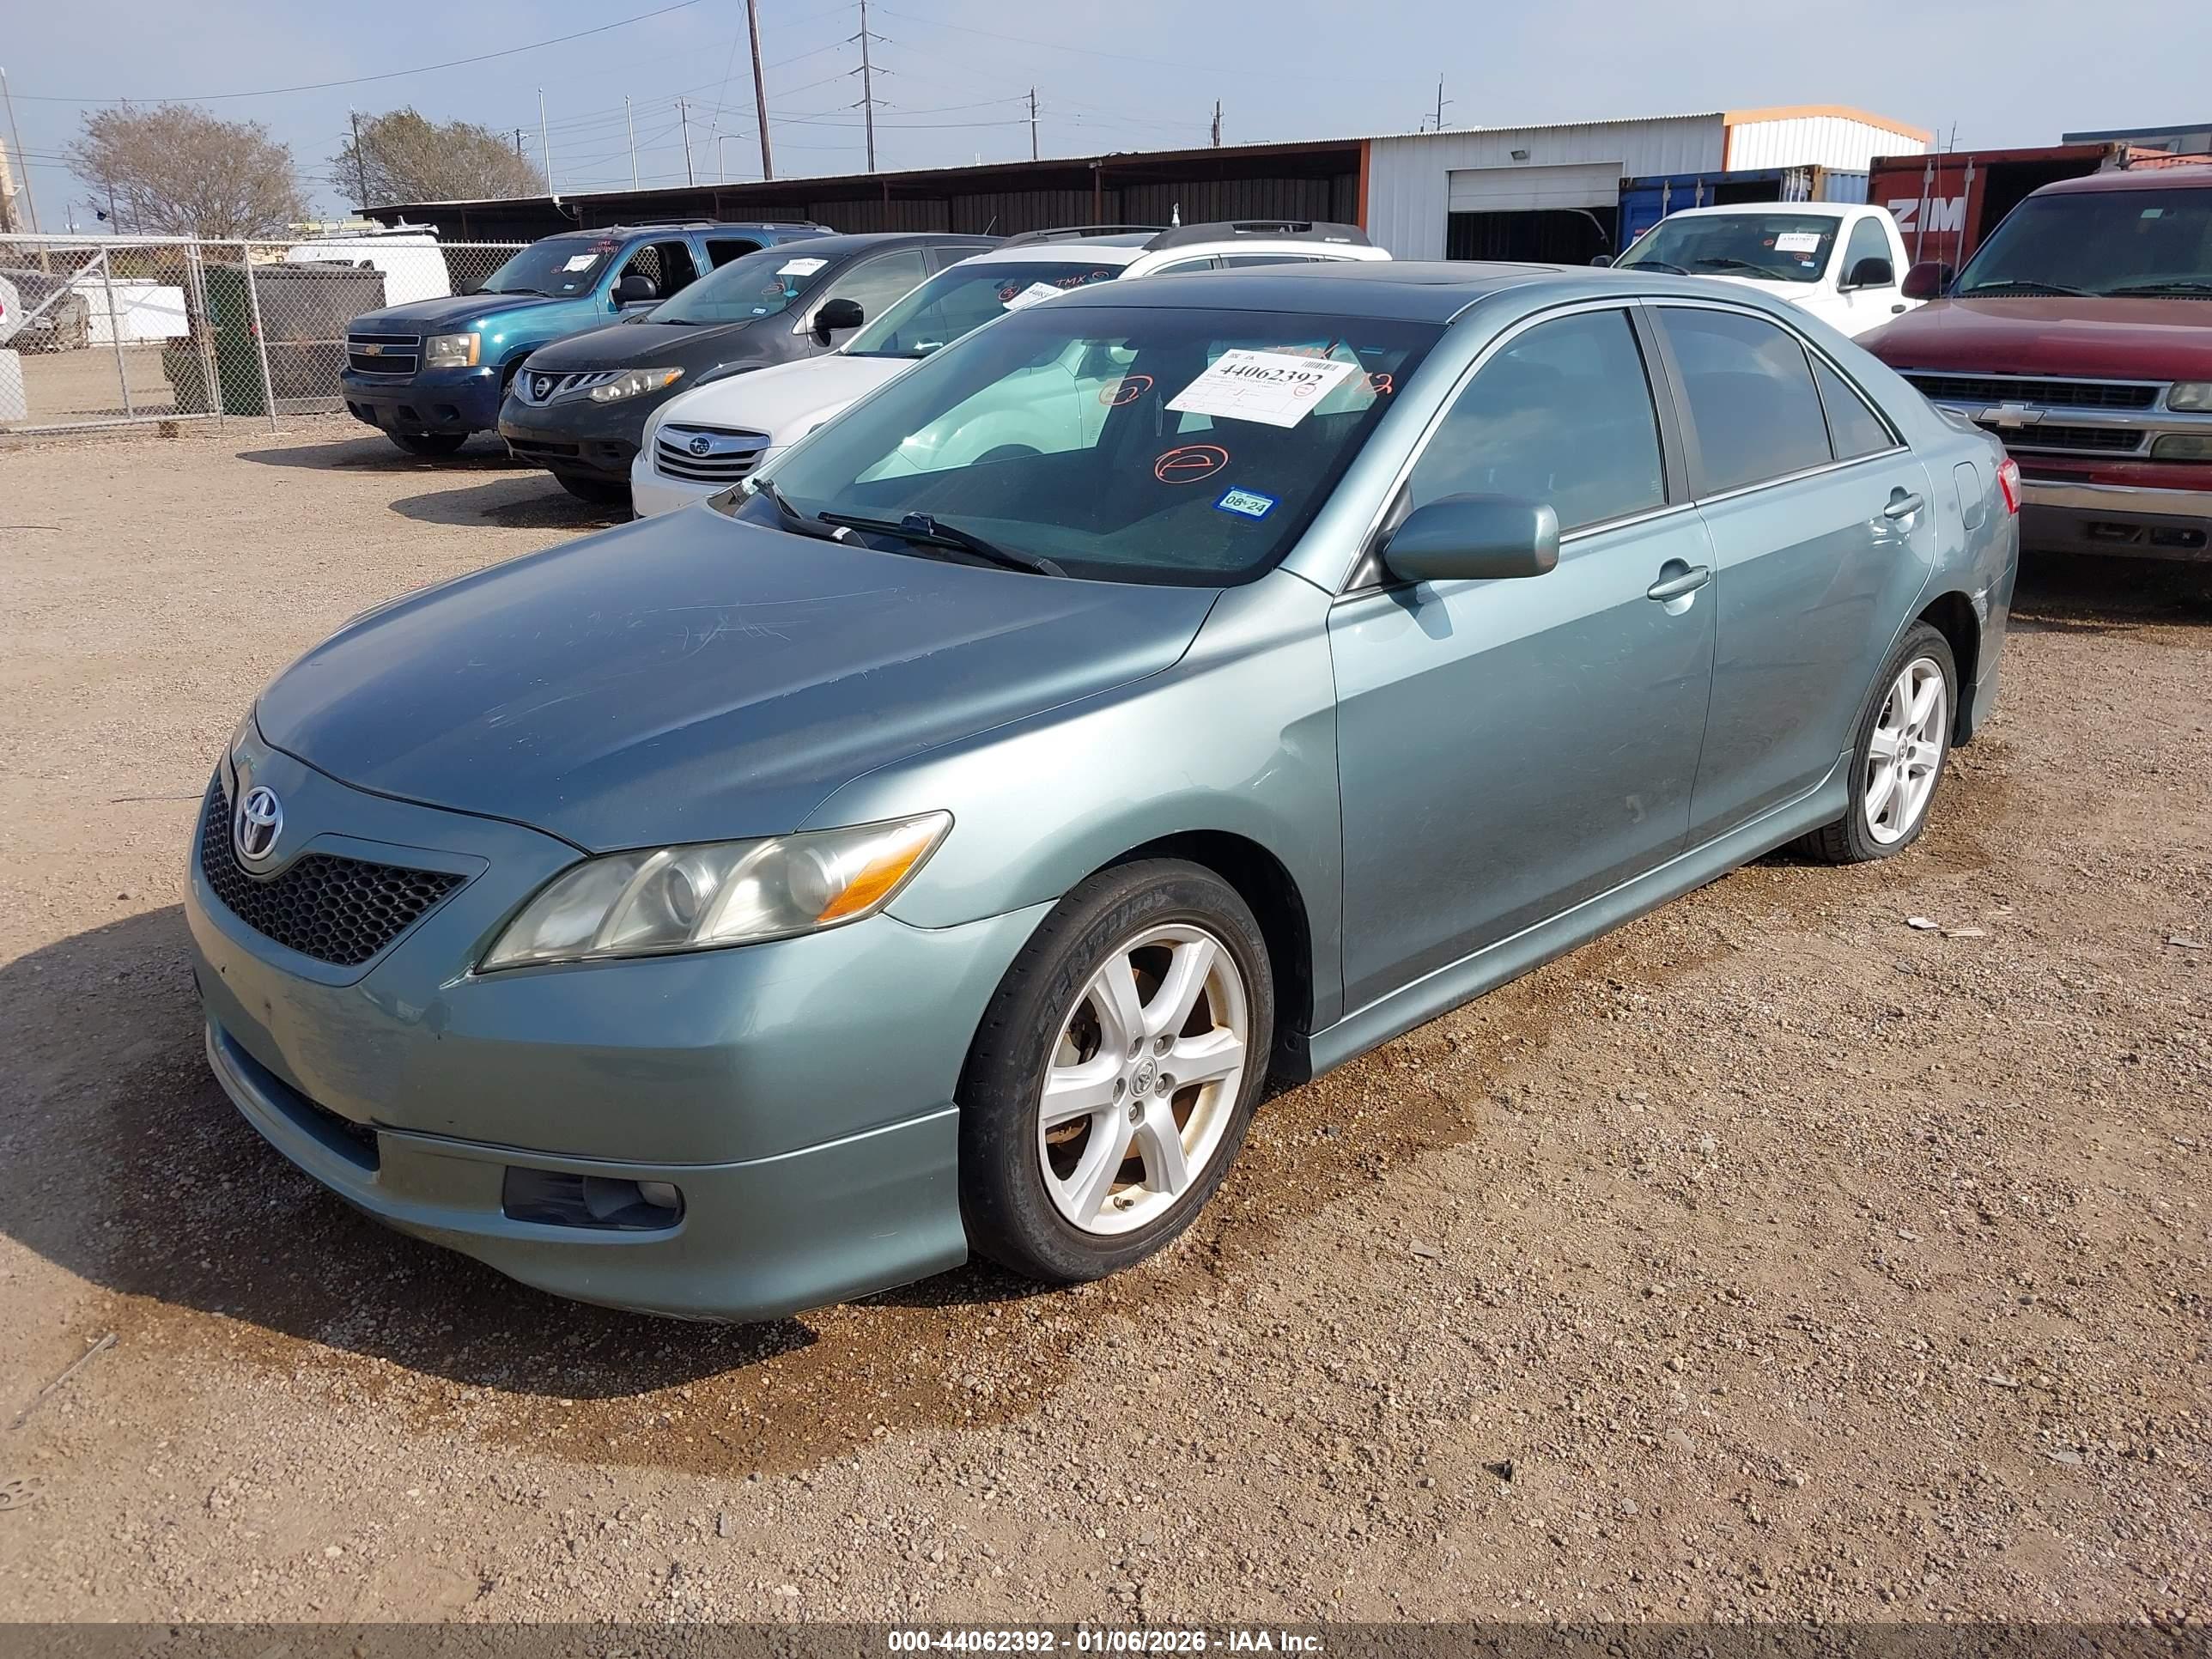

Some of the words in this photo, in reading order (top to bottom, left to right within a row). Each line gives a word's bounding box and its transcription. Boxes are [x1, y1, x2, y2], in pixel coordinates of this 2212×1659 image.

[1888, 197, 1966, 233] ZIM
[1055, 274, 1087, 287] TMX
[1219, 363, 1323, 386] 44062392
[1225, 495, 1244, 507] 08
[1245, 501, 1267, 513] 24
